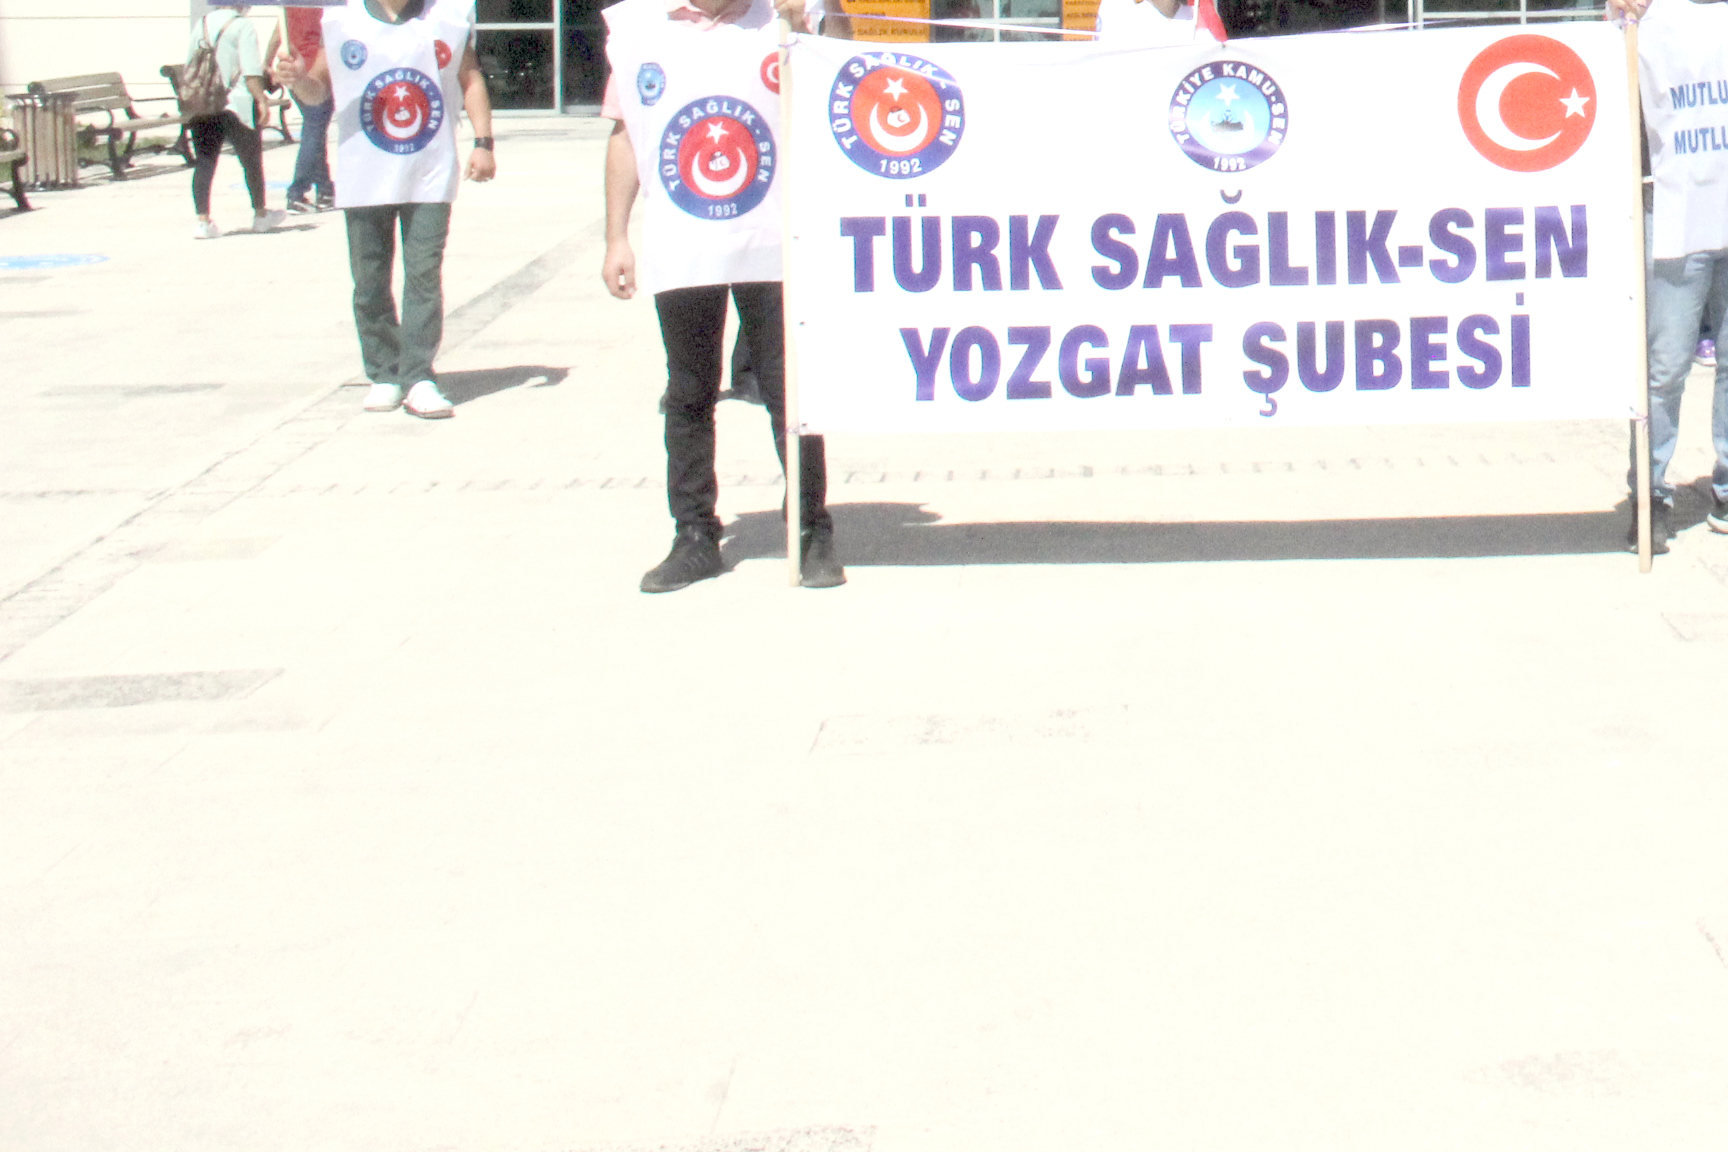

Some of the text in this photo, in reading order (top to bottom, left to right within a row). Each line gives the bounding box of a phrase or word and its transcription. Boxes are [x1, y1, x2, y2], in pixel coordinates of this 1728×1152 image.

[832, 81, 858, 149] TÜRK
[662, 132, 682, 191] TÜRK
[880, 158, 922, 175] 1992
[1213, 156, 1247, 171] 1992
[707, 203, 738, 218] 1992
[840, 189, 1587, 292] TÜRK SAĞLIK-SEN
[899, 292, 1531, 417] YOZGAT ŞUBESİ
